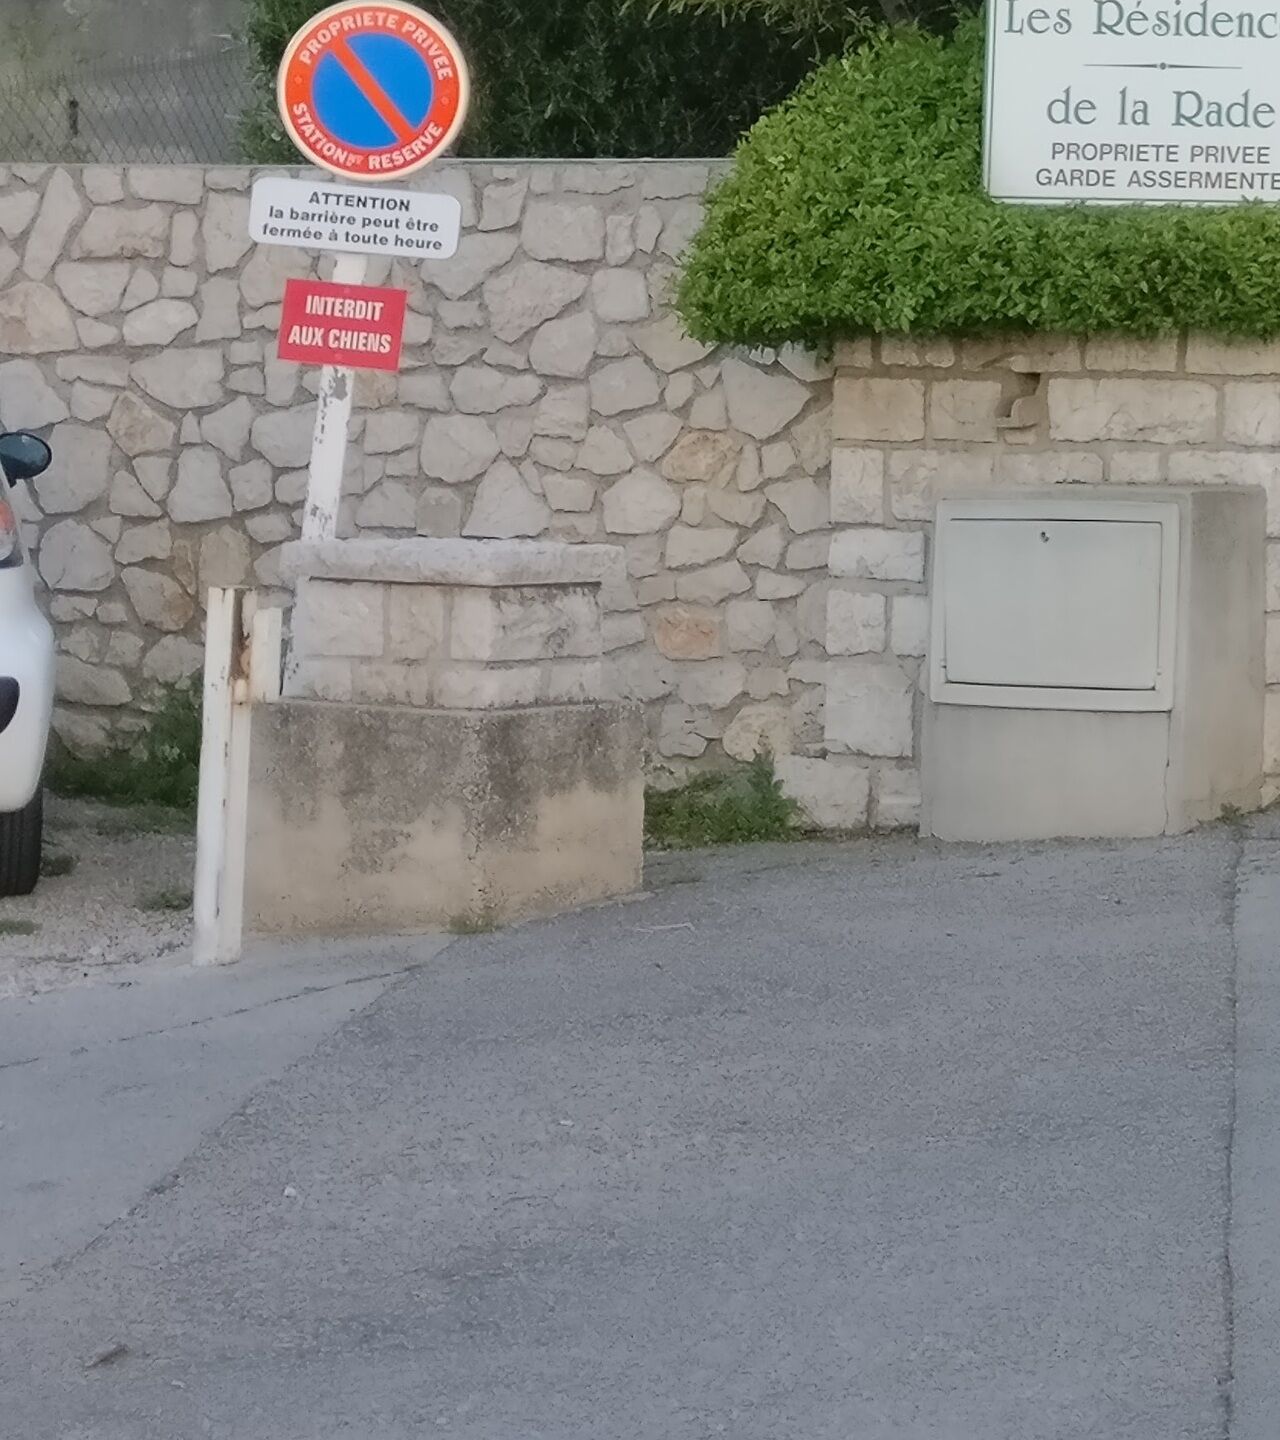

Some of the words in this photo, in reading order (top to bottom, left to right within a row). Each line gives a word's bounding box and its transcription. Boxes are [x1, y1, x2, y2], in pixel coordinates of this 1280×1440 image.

[299, 12, 398, 65] PROPRIETE
[402, 20, 453, 81] PRIVEE
[1047, 86, 1097, 125] de
[1118, 87, 1150, 126] la
[1172, 89, 1276, 129] Rade
[369, 121, 443, 170] RESERVE
[1051, 143, 1180, 163] PROPRIETE
[1190, 145, 1270, 165] PRIVEE
[1036, 168, 1115, 189] GARDE
[308, 191, 411, 212] ATTENTION
[268, 205, 284, 220] la
[289, 207, 356, 227] barrière
[361, 216, 400, 234] peut
[405, 216, 439, 233] être
[262, 223, 323, 241] fermée
[328, 227, 339, 242] à
[344, 231, 389, 246] toute
[394, 234, 443, 251] heure
[305, 294, 384, 322] INTERDIT
[287, 325, 324, 348] AUX
[328, 328, 392, 354] CHIENS
